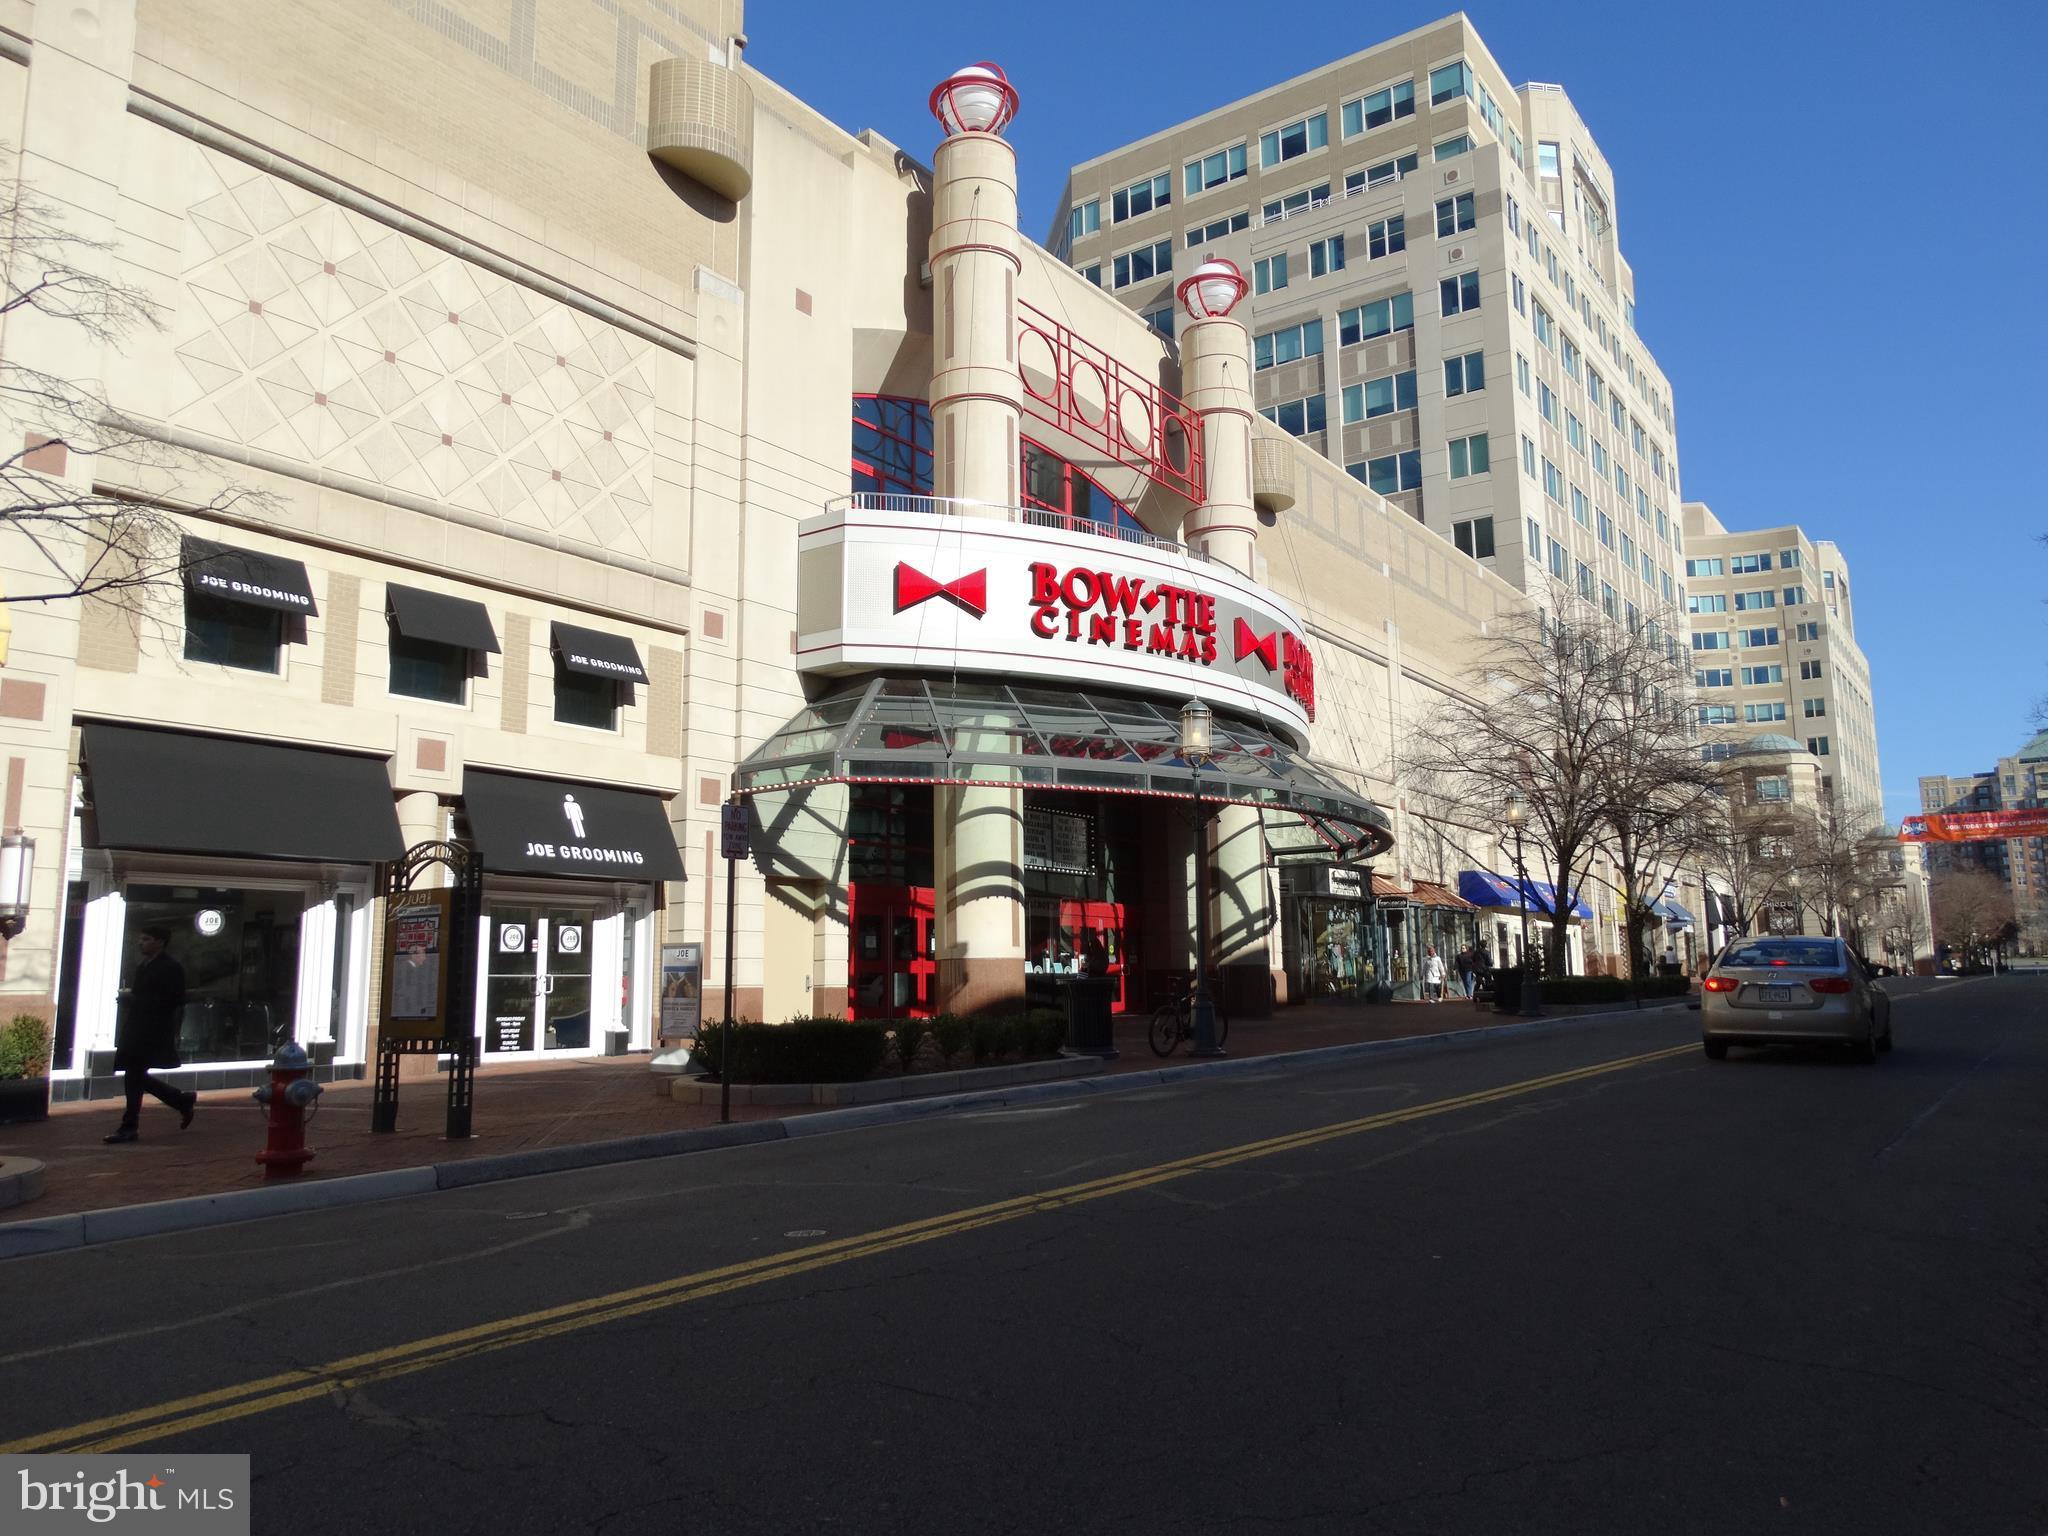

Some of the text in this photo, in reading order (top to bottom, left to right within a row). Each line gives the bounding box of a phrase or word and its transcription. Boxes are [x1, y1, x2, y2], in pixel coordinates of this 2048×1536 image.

[201, 575, 309, 605] JOE GROOMING
[1029, 605, 1218, 666] CINEMAS
[571, 654, 642, 675] JOE GROOMING
[730, 808, 742, 819] NO
[725, 821, 747, 832] PARKING
[526, 842, 644, 864] JOE GROOMING
[676, 949, 689, 958] JOE
